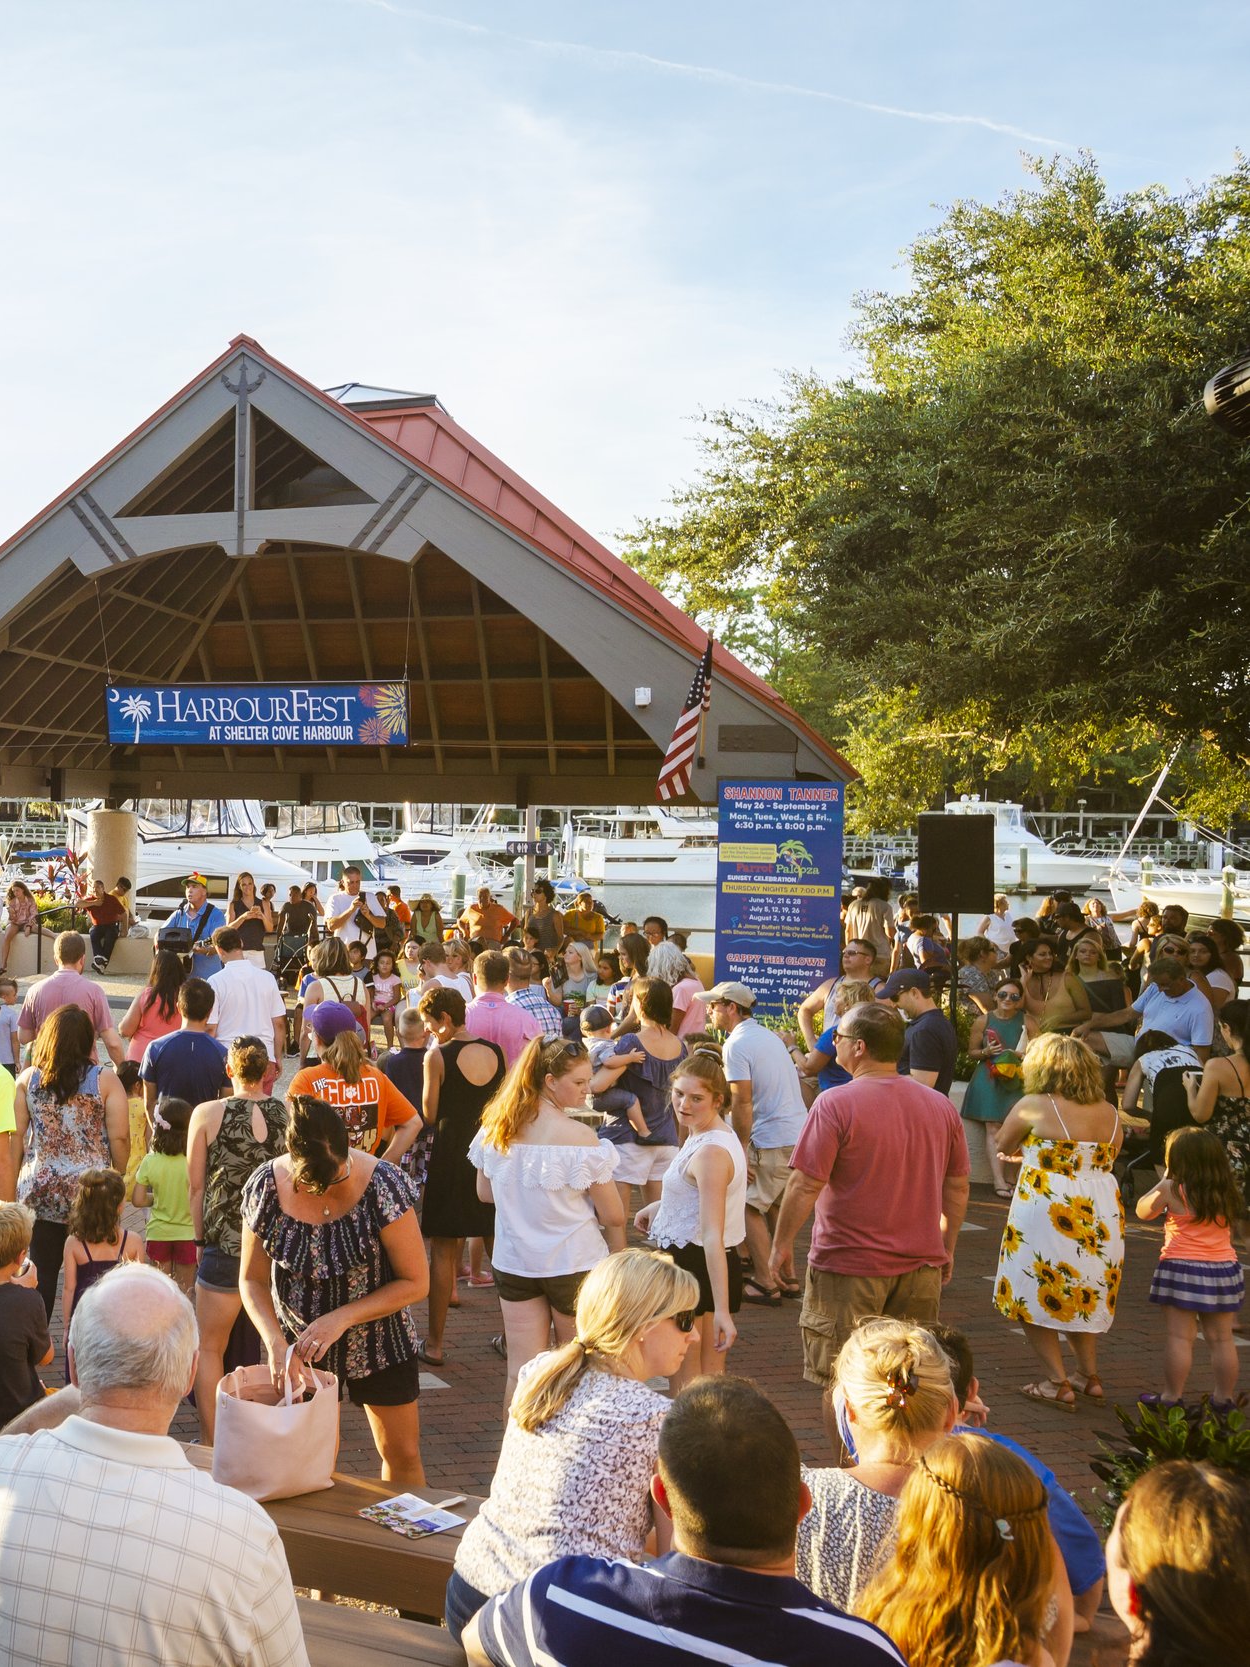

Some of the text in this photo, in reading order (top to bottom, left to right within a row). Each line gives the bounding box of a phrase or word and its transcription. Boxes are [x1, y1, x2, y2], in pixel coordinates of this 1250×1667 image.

[209, 726, 353, 740] AT SHELTER COVE HARBOUR
[724, 787, 838, 801] SHANNON TANNER
[735, 802, 752, 810] May
[773, 802, 819, 811] September
[736, 863, 820, 875] Parrot Palooza
[726, 953, 826, 967] CAPPY THE CLOWN
[730, 965, 746, 973] May
[767, 967, 813, 976] September
[741, 976, 774, 985] Monday
[783, 978, 810, 987] Friday,
[312, 1078, 328, 1093] THE
[321, 1078, 380, 1107] GOOD
